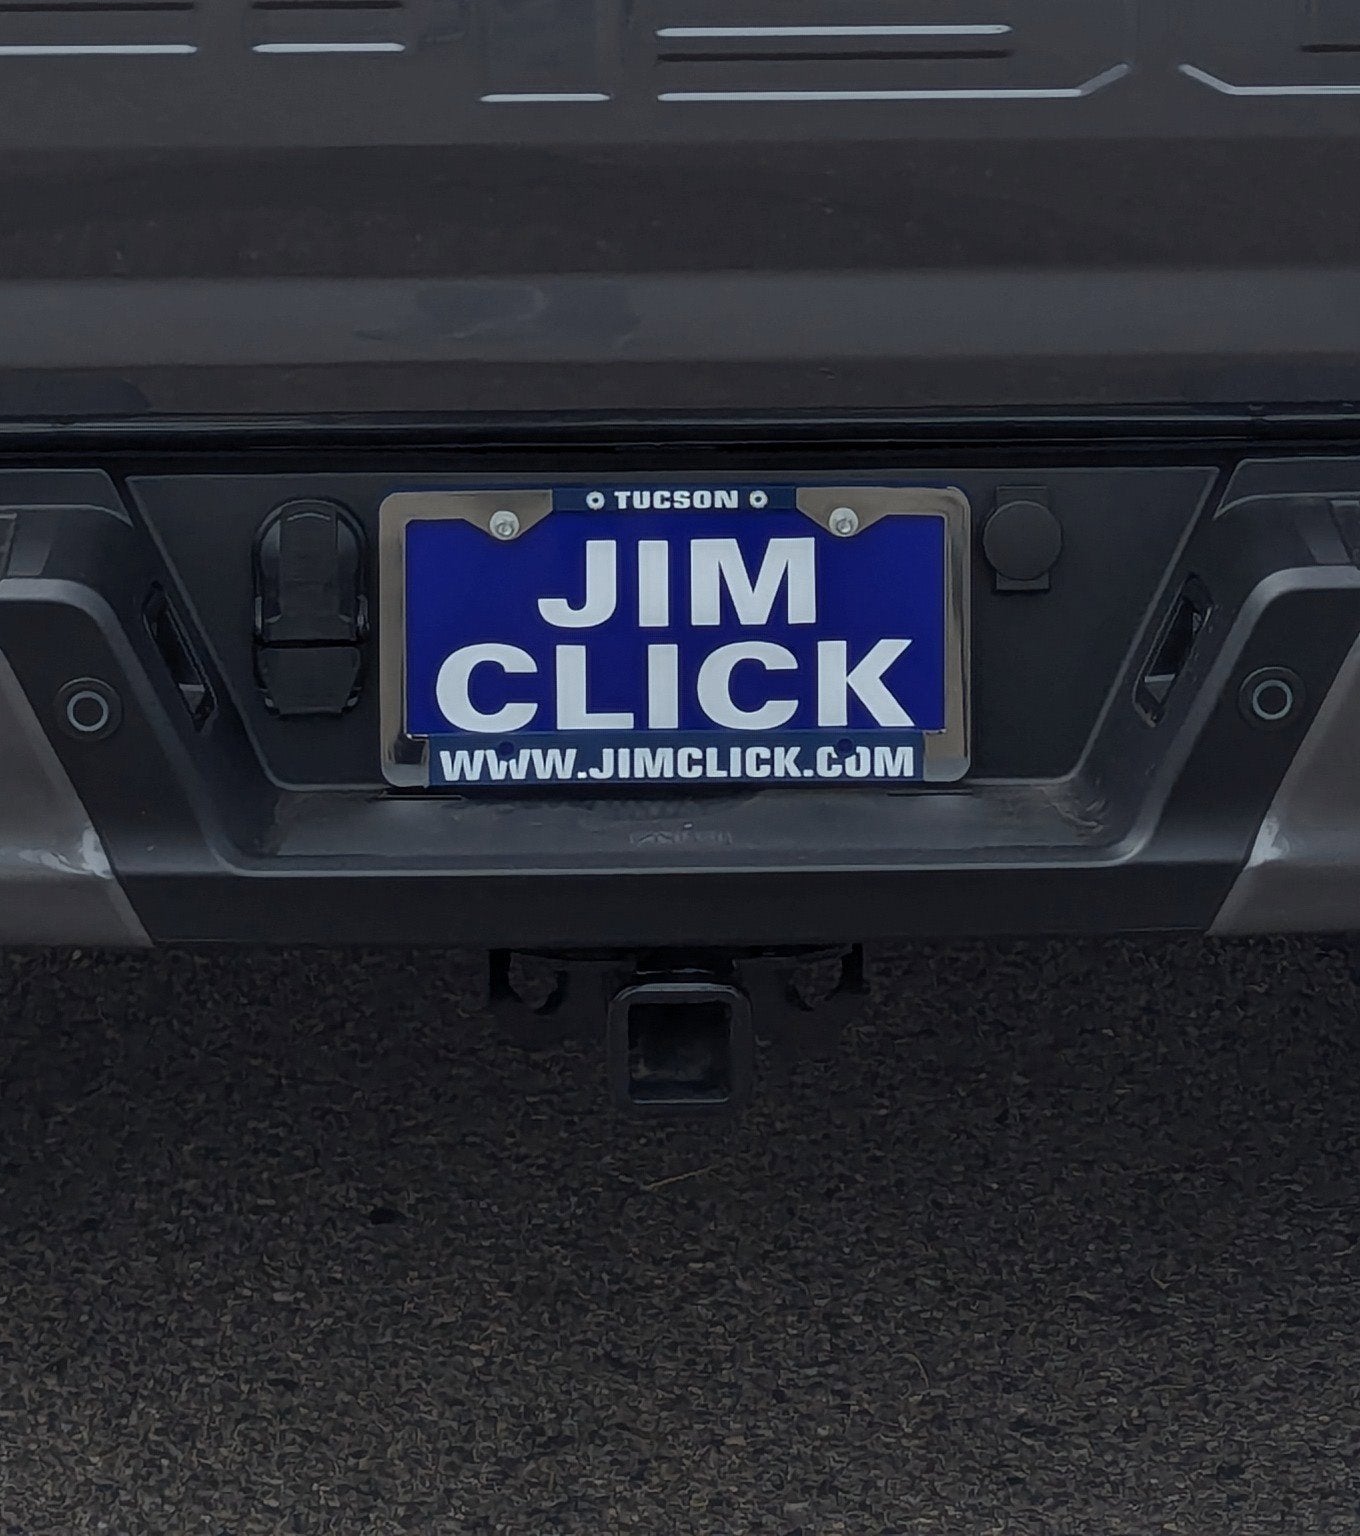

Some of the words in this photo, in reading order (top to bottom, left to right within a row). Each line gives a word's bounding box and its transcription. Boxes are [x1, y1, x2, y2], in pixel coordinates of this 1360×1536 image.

[614, 490, 739, 510] TUCSON
[538, 537, 817, 627] JIM
[436, 639, 915, 732] CLICK
[440, 746, 914, 782] WWW.JIMCLICK.COM
